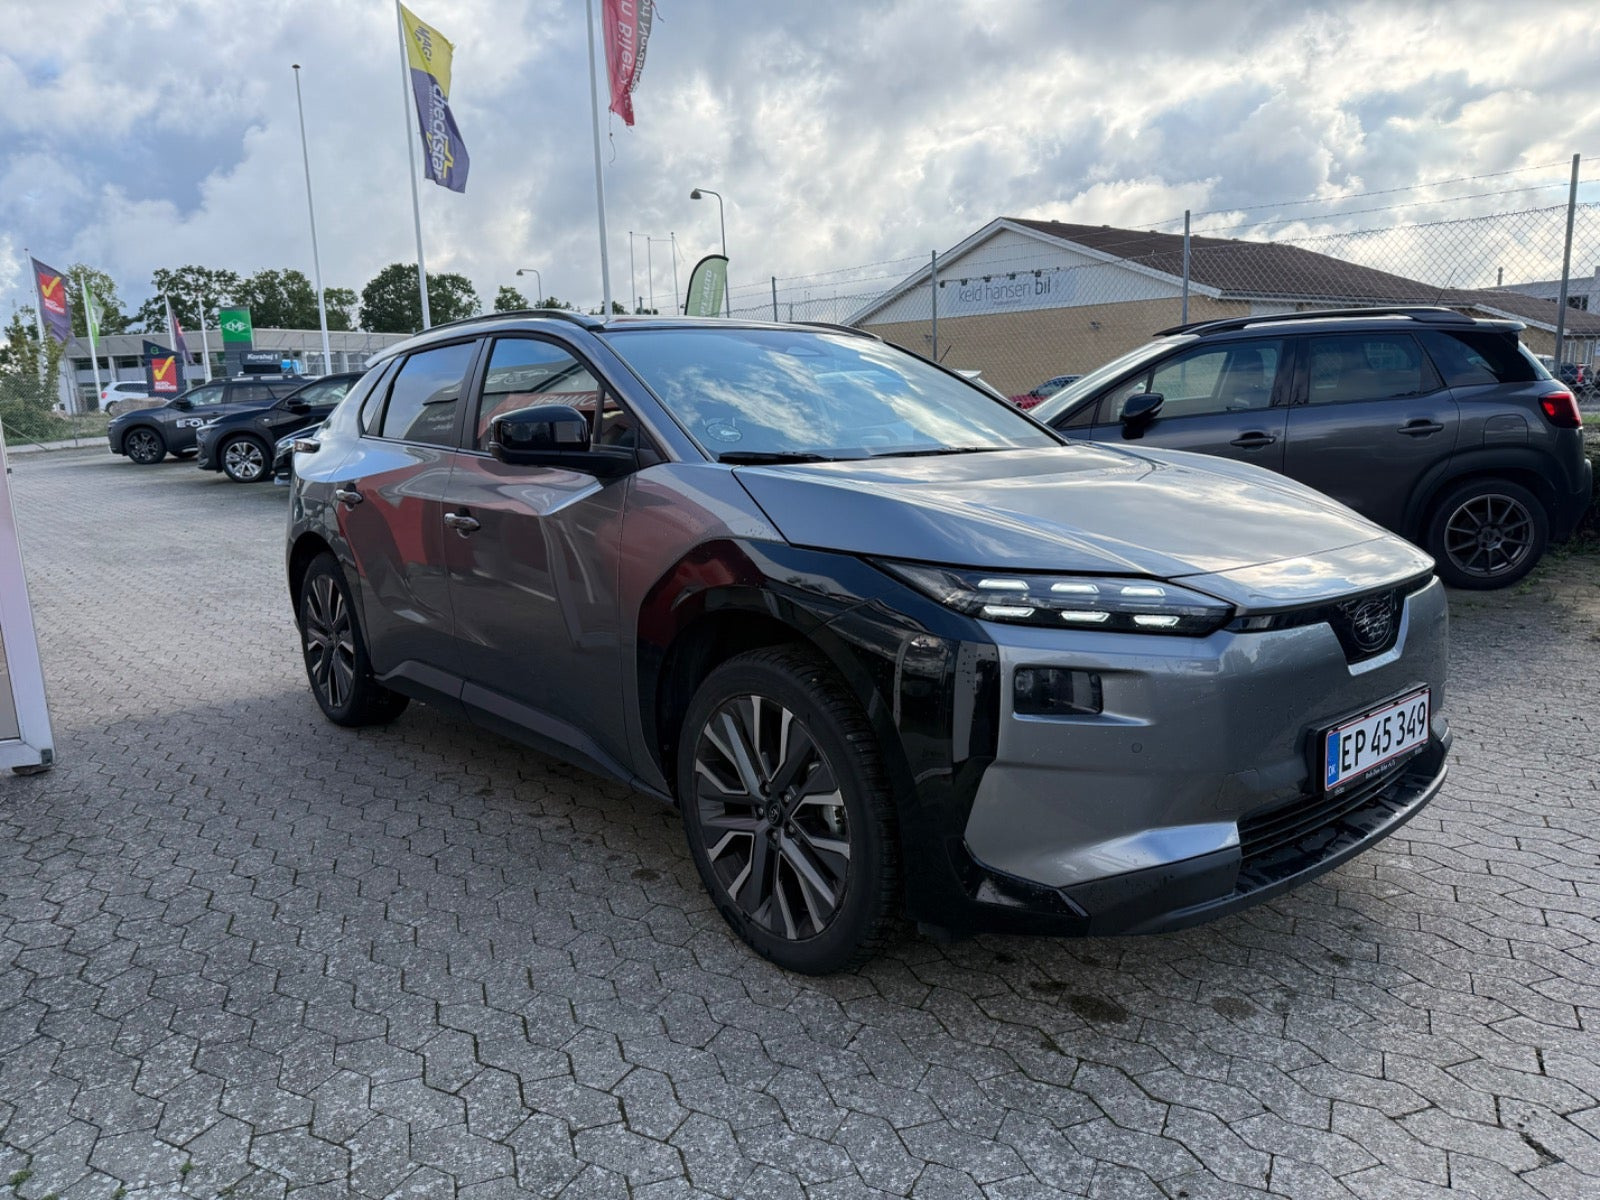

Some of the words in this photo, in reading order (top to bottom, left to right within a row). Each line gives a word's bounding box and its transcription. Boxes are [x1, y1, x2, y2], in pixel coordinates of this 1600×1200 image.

[431, 84, 449, 179] checkstar
[985, 283, 1031, 300] hansen
[1035, 276, 1051, 296] bil
[1341, 729, 1366, 773] EP
[1371, 716, 1392, 756] 45
[1396, 701, 1426, 746] 349
[1328, 764, 1336, 777] DK
